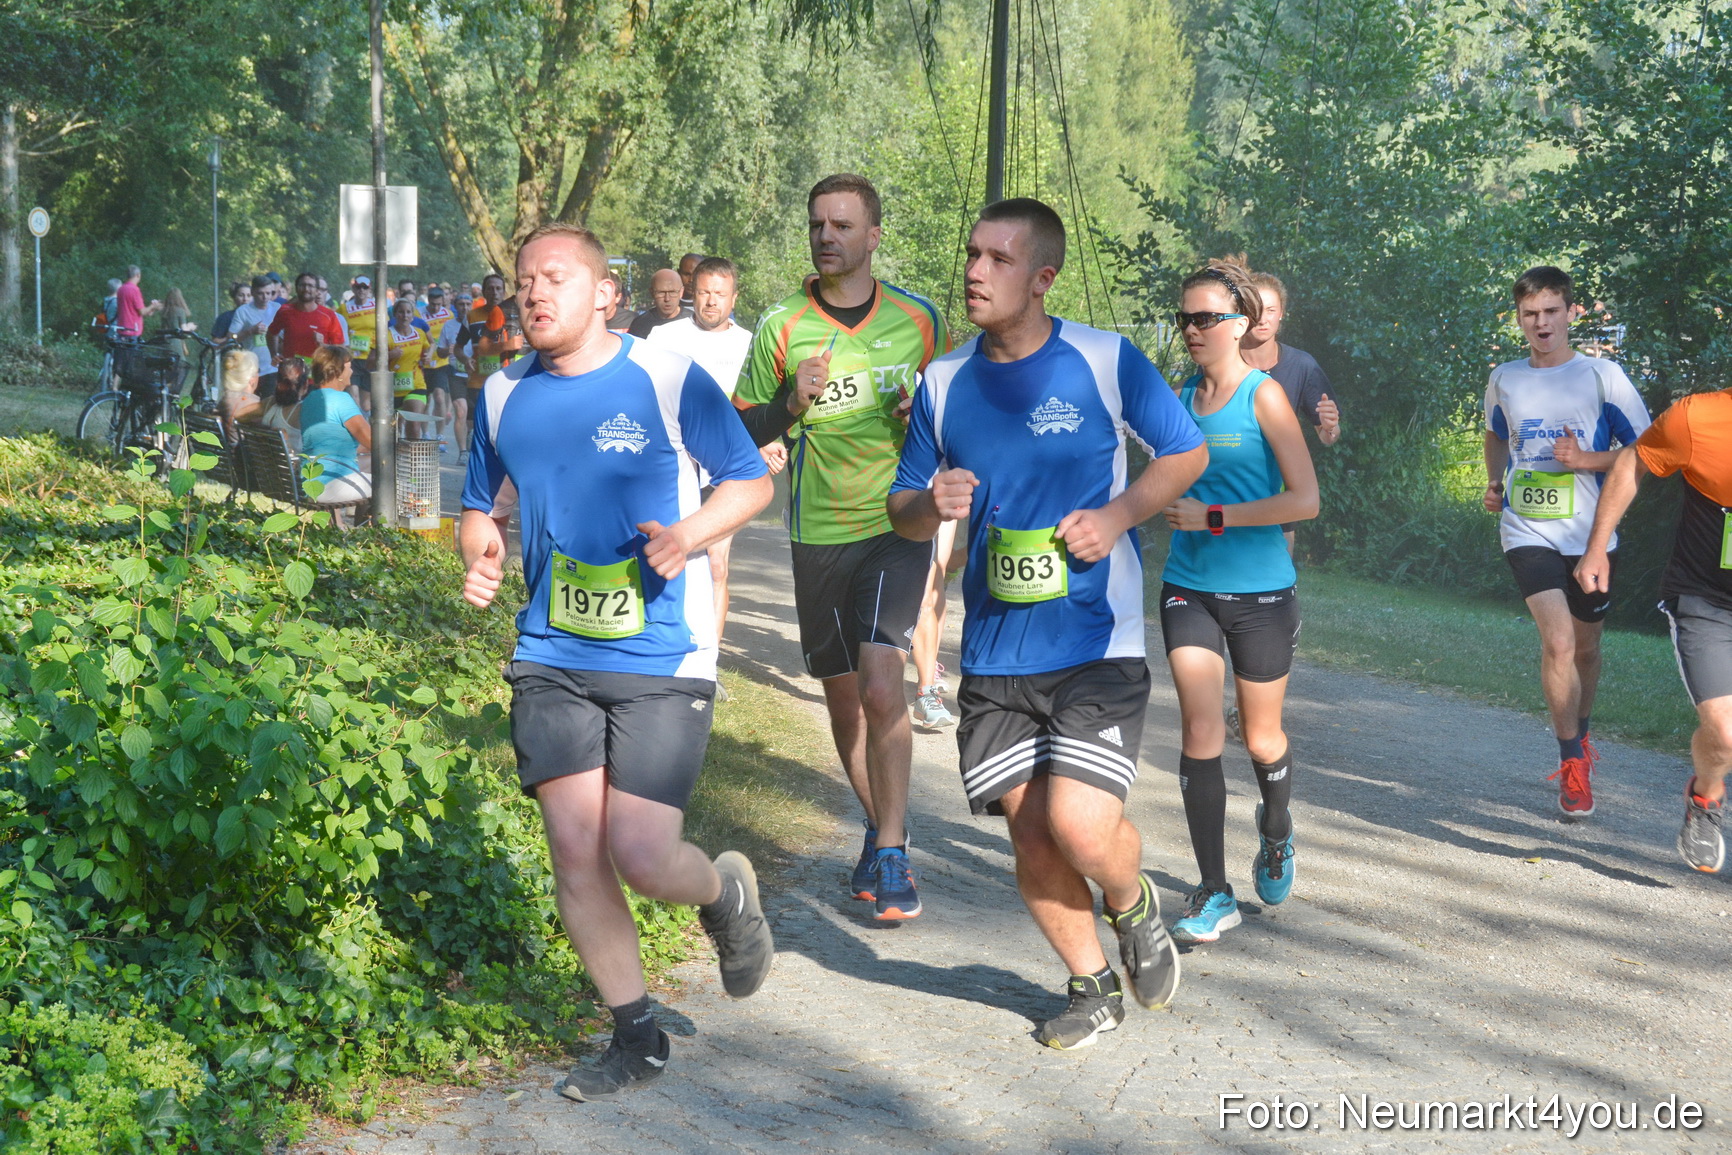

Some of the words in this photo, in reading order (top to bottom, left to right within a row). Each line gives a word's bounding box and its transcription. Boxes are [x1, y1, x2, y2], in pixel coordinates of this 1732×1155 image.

[818, 404, 838, 412] Kühne
[839, 398, 859, 407] Martin
[1031, 412, 1079, 422] TRANSpofix
[597, 430, 645, 440] TRANSpofix
[1522, 487, 1559, 505] 636
[990, 554, 1054, 582] 1963
[997, 581, 1025, 590] Haubner
[560, 583, 630, 618] 1972
[565, 611, 596, 625] Pelowski
[598, 618, 624, 626] Maciej
